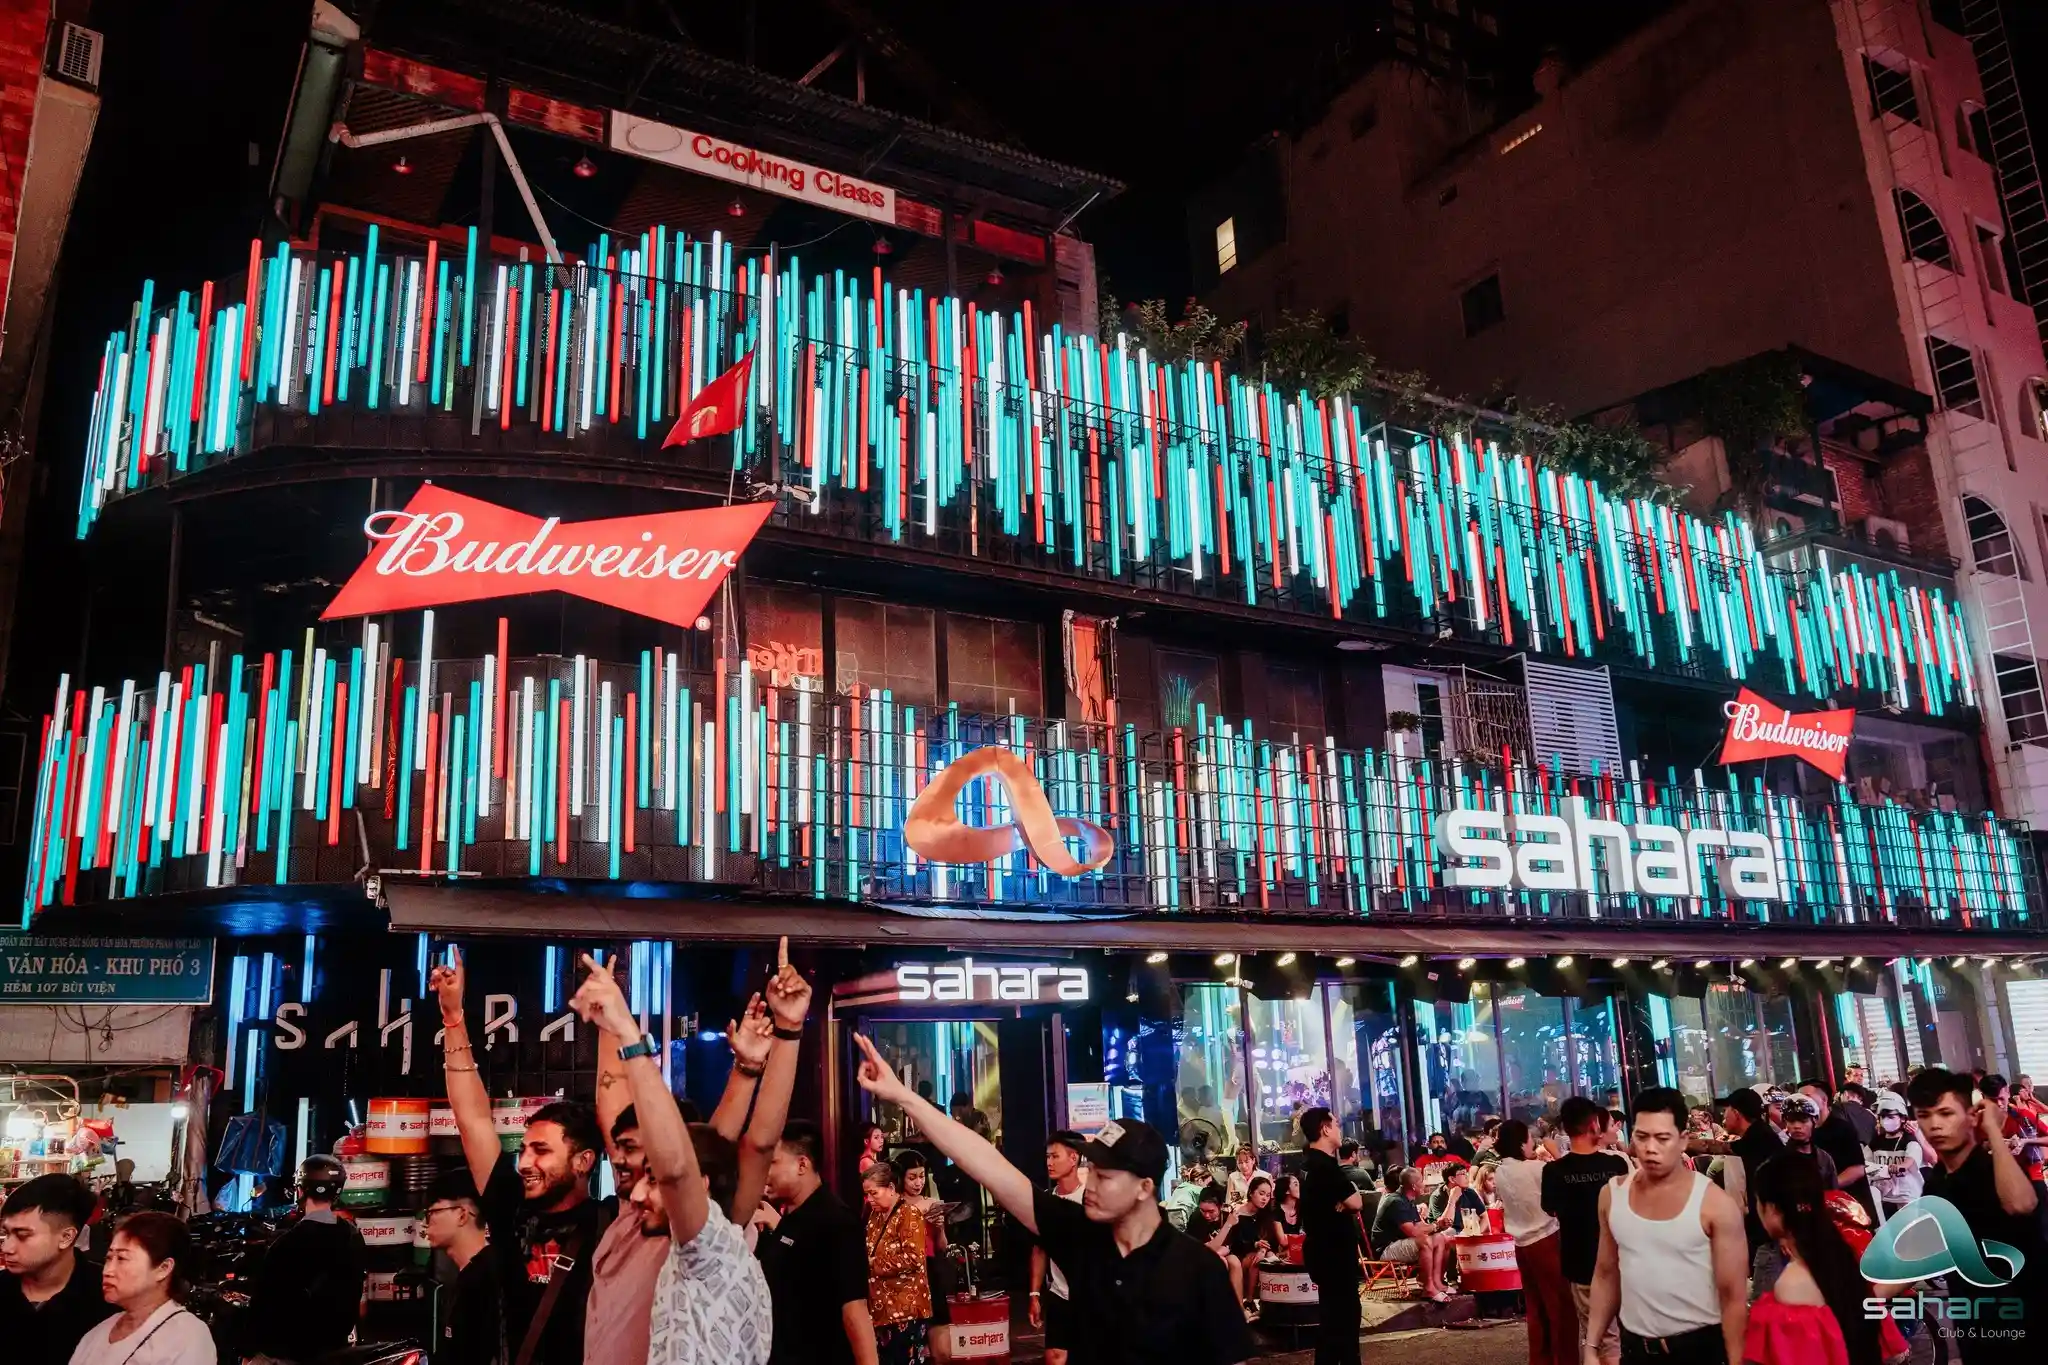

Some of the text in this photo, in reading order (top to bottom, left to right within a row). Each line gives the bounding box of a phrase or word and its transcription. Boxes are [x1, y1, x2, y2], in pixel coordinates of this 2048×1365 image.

[692, 134, 886, 208] Cooking Class
[363, 510, 737, 580] Budweiser
[1724, 701, 1849, 753] Budweiser
[1434, 796, 1779, 900] sahara
[7, 953, 45, 974] VĂN
[50, 953, 88, 975] HÓA
[105, 958, 144, 976] KHU
[148, 951, 187, 976] PHỐ
[190, 958, 201, 976] 3
[897, 957, 1089, 1001] sahara
[37, 983, 57, 993] 107
[62, 980, 84, 993] BÙI
[87, 981, 116, 996] VIỆN
[275, 969, 574, 1075] SAHRA
[363, 1225, 395, 1237] sahara
[970, 1332, 1004, 1346] sahara
